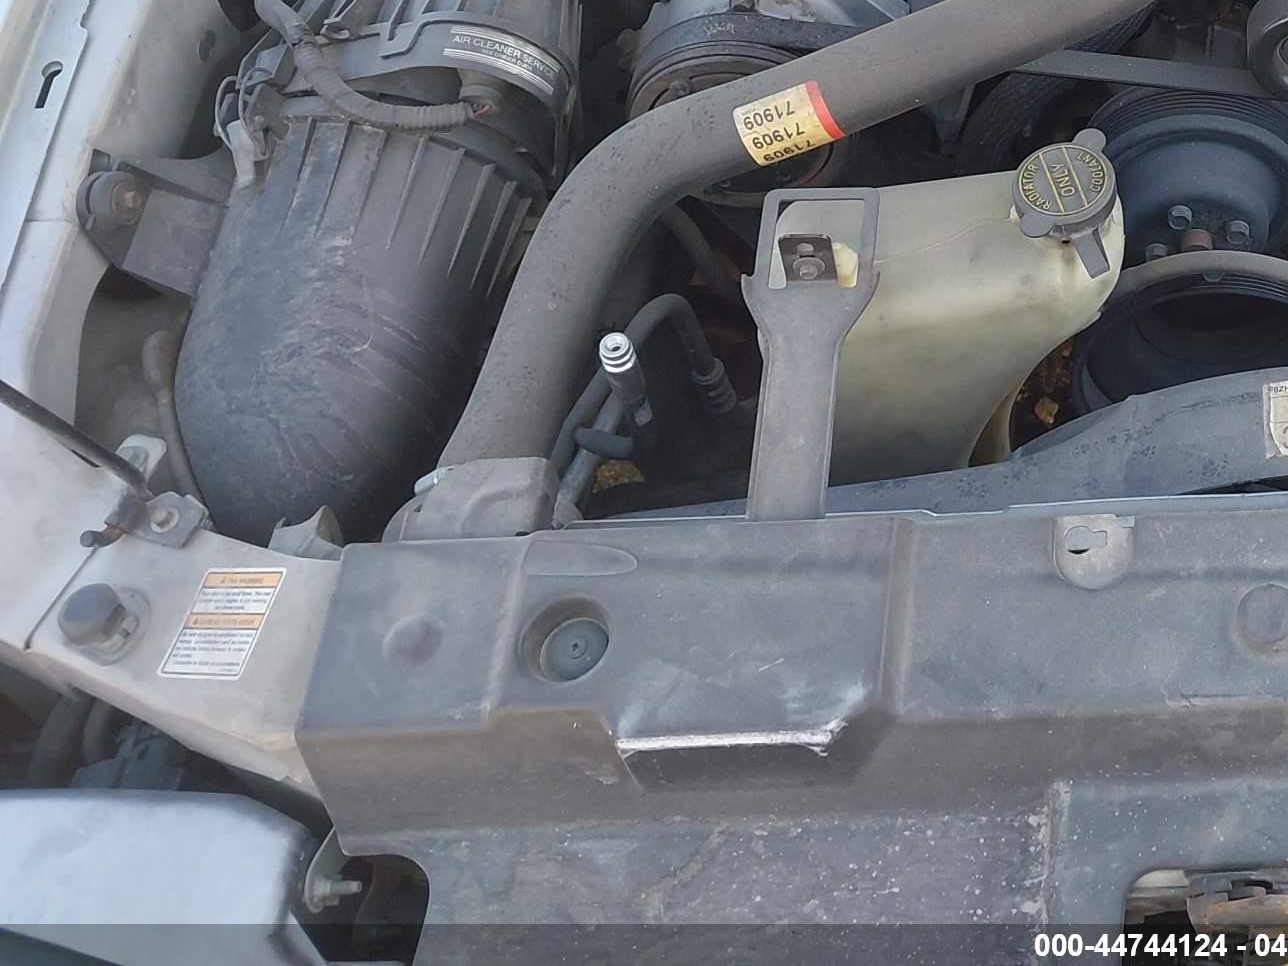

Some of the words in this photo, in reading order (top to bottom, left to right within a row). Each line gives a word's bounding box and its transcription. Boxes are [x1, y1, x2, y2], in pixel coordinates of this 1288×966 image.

[452, 34, 471, 45] AIR
[473, 38, 521, 59] CLEANER
[743, 100, 796, 131] 71909
[752, 121, 805, 150] 71909
[1021, 163, 1052, 211] RADIATOR
[1051, 163, 1076, 197] ONLY
[1075, 151, 1106, 193] COOLANT
